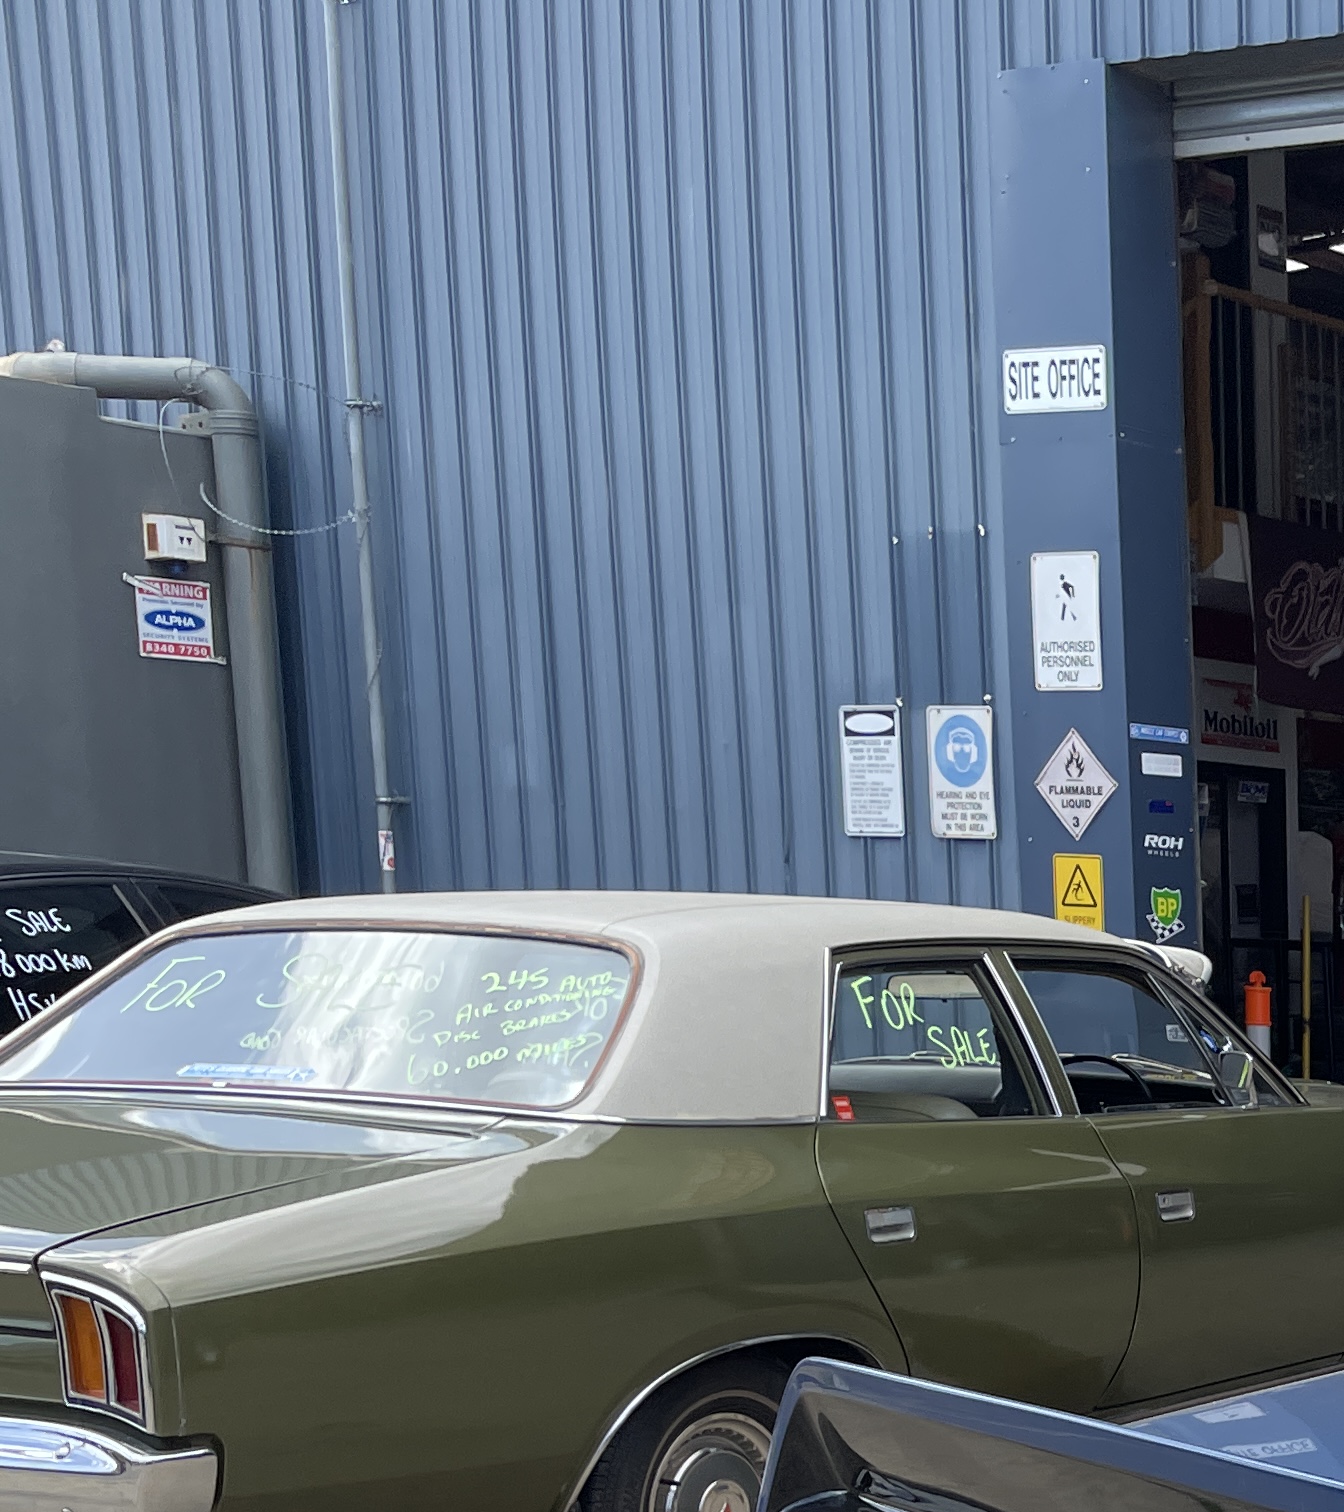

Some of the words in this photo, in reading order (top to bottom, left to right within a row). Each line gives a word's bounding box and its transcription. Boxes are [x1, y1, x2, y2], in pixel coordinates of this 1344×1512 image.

[1008, 361, 1041, 401] SITE
[1047, 357, 1101, 399] OFFICE
[154, 614, 197, 628] ALPHA
[145, 643, 175, 654] 8340
[179, 645, 208, 656] 7750
[1040, 640, 1096, 654] AUTHORISED
[1041, 655, 1095, 668] PERSONNEL
[1057, 670, 1080, 682] ONLY
[1203, 709, 1278, 741] Mobiloil
[936, 791, 962, 800] HEARING
[965, 791, 978, 800] AND
[979, 791, 990, 800] EYE
[1048, 785, 1103, 796] FLAMMABLE
[946, 802, 982, 811] PROTECTION
[1061, 798, 1092, 809] LIQUID
[941, 813, 959, 821] MUST
[960, 813, 968, 821] BE
[970, 813, 988, 821] WORN
[1072, 816, 1080, 828] 3
[946, 824, 952, 832] IN
[954, 824, 967, 832] THIS
[969, 824, 985, 832] AREA
[1144, 834, 1184, 850] ROH
[1147, 849, 1180, 858] WHEELS
[1157, 897, 1178, 919] BP
[5, 908, 71, 936] SALE
[120, 957, 226, 1014] FOR
[481, 968, 549, 993] 245
[560, 971, 613, 992] AUTO
[851, 976, 925, 1030] FOR
[456, 1003, 499, 1026] AIR
[501, 1008, 572, 1036] BRAKES
[927, 1027, 997, 1069] SALE
